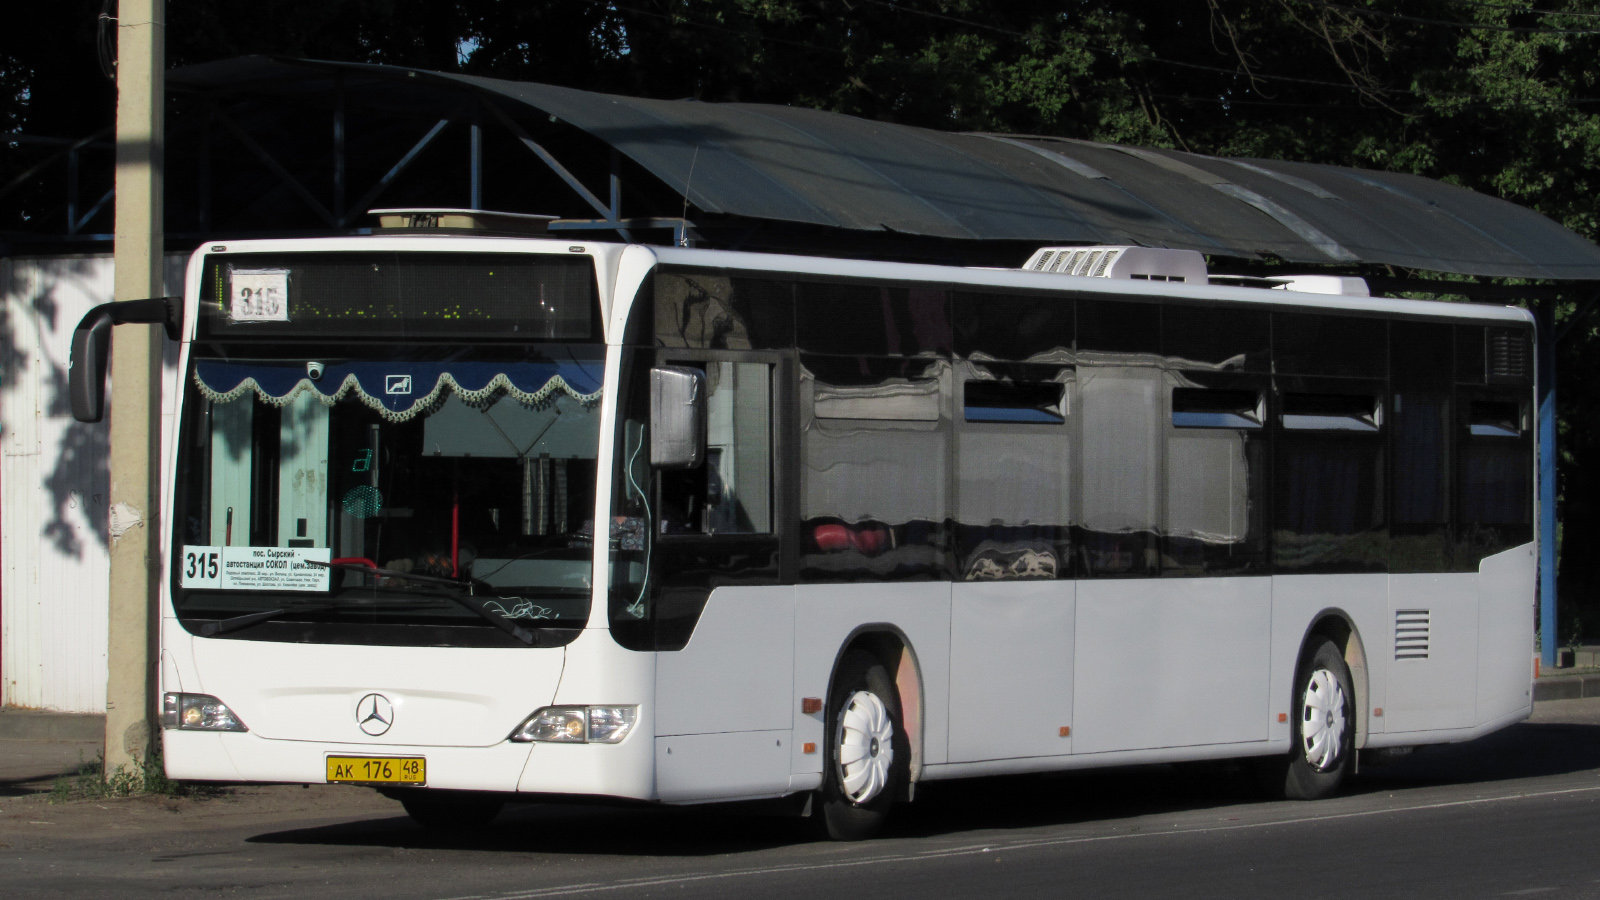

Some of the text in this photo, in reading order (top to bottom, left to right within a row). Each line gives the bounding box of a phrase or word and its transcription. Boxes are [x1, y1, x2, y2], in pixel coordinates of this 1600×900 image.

[241, 287, 279, 316] 315
[253, 550, 266, 558] пос.
[267, 549, 295, 559] Сырский
[187, 552, 219, 579] 315
[226, 561, 265, 570] автостанция
[265, 560, 288, 569] СОКОЛ
[363, 761, 393, 779] 176
[402, 760, 419, 774] 48
